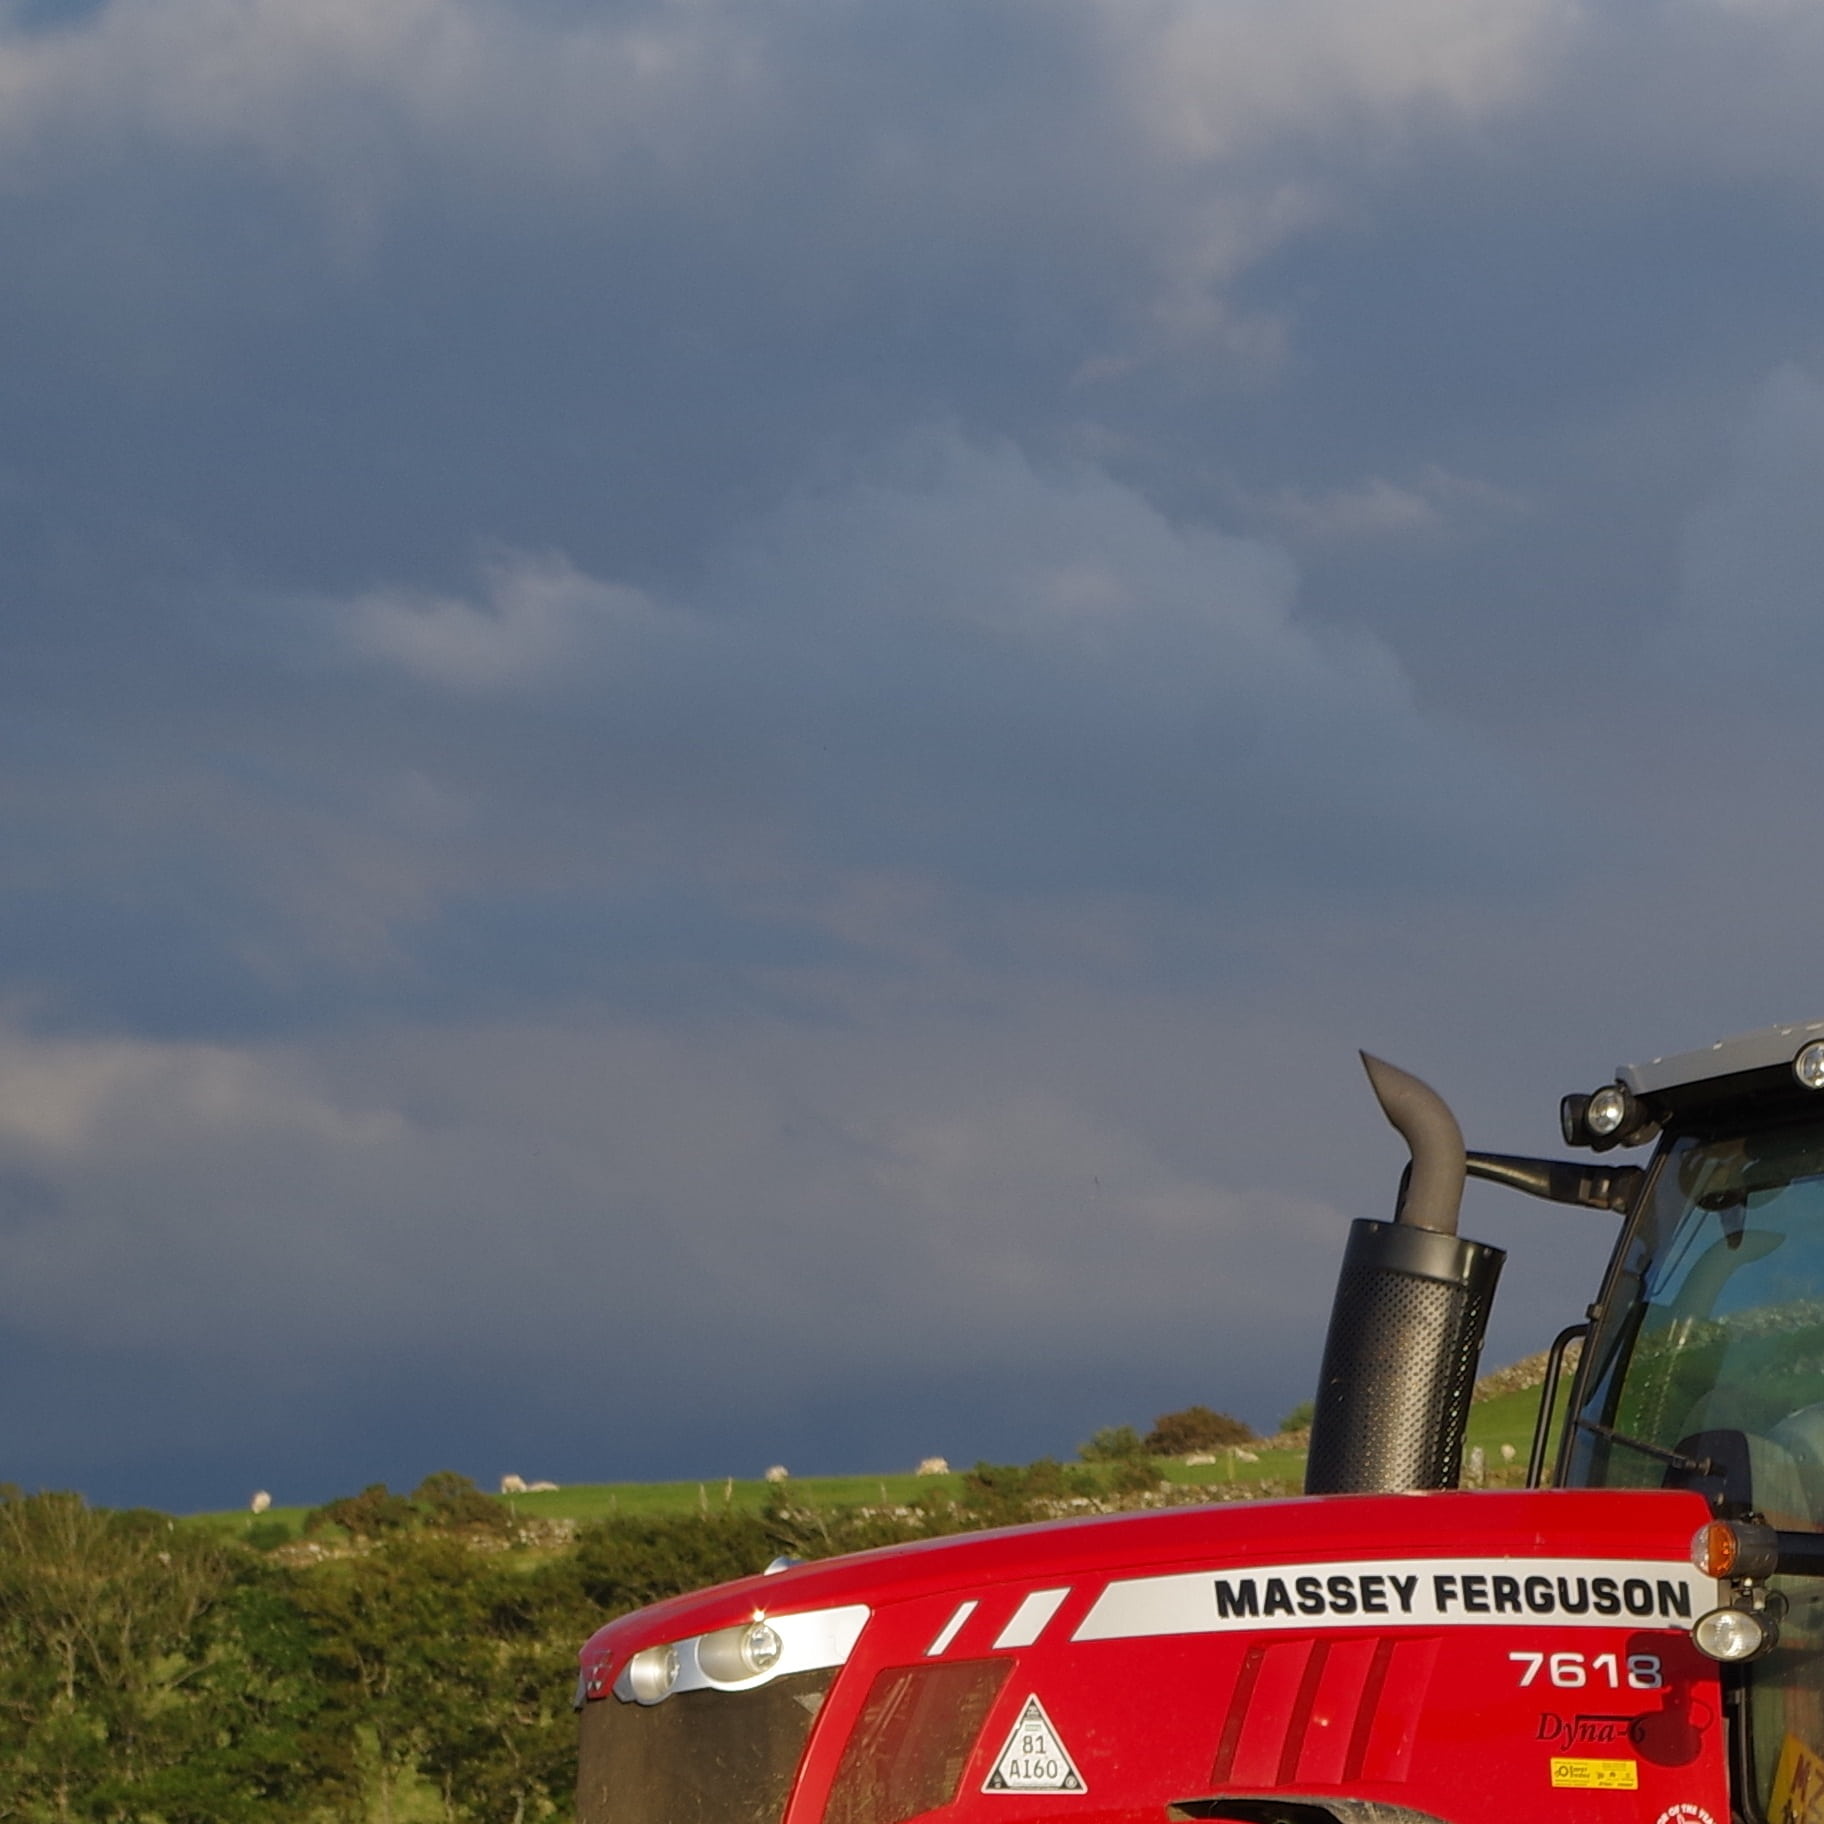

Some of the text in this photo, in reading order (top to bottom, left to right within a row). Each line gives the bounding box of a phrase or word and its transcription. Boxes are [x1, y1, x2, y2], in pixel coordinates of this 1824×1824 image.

[1214, 1575, 1692, 1619] MASSEY FERGUSON
[1508, 1652, 1663, 1689] 7618
[1022, 1735, 1046, 1754] 81
[1536, 1713, 1647, 1751] Dyna-6
